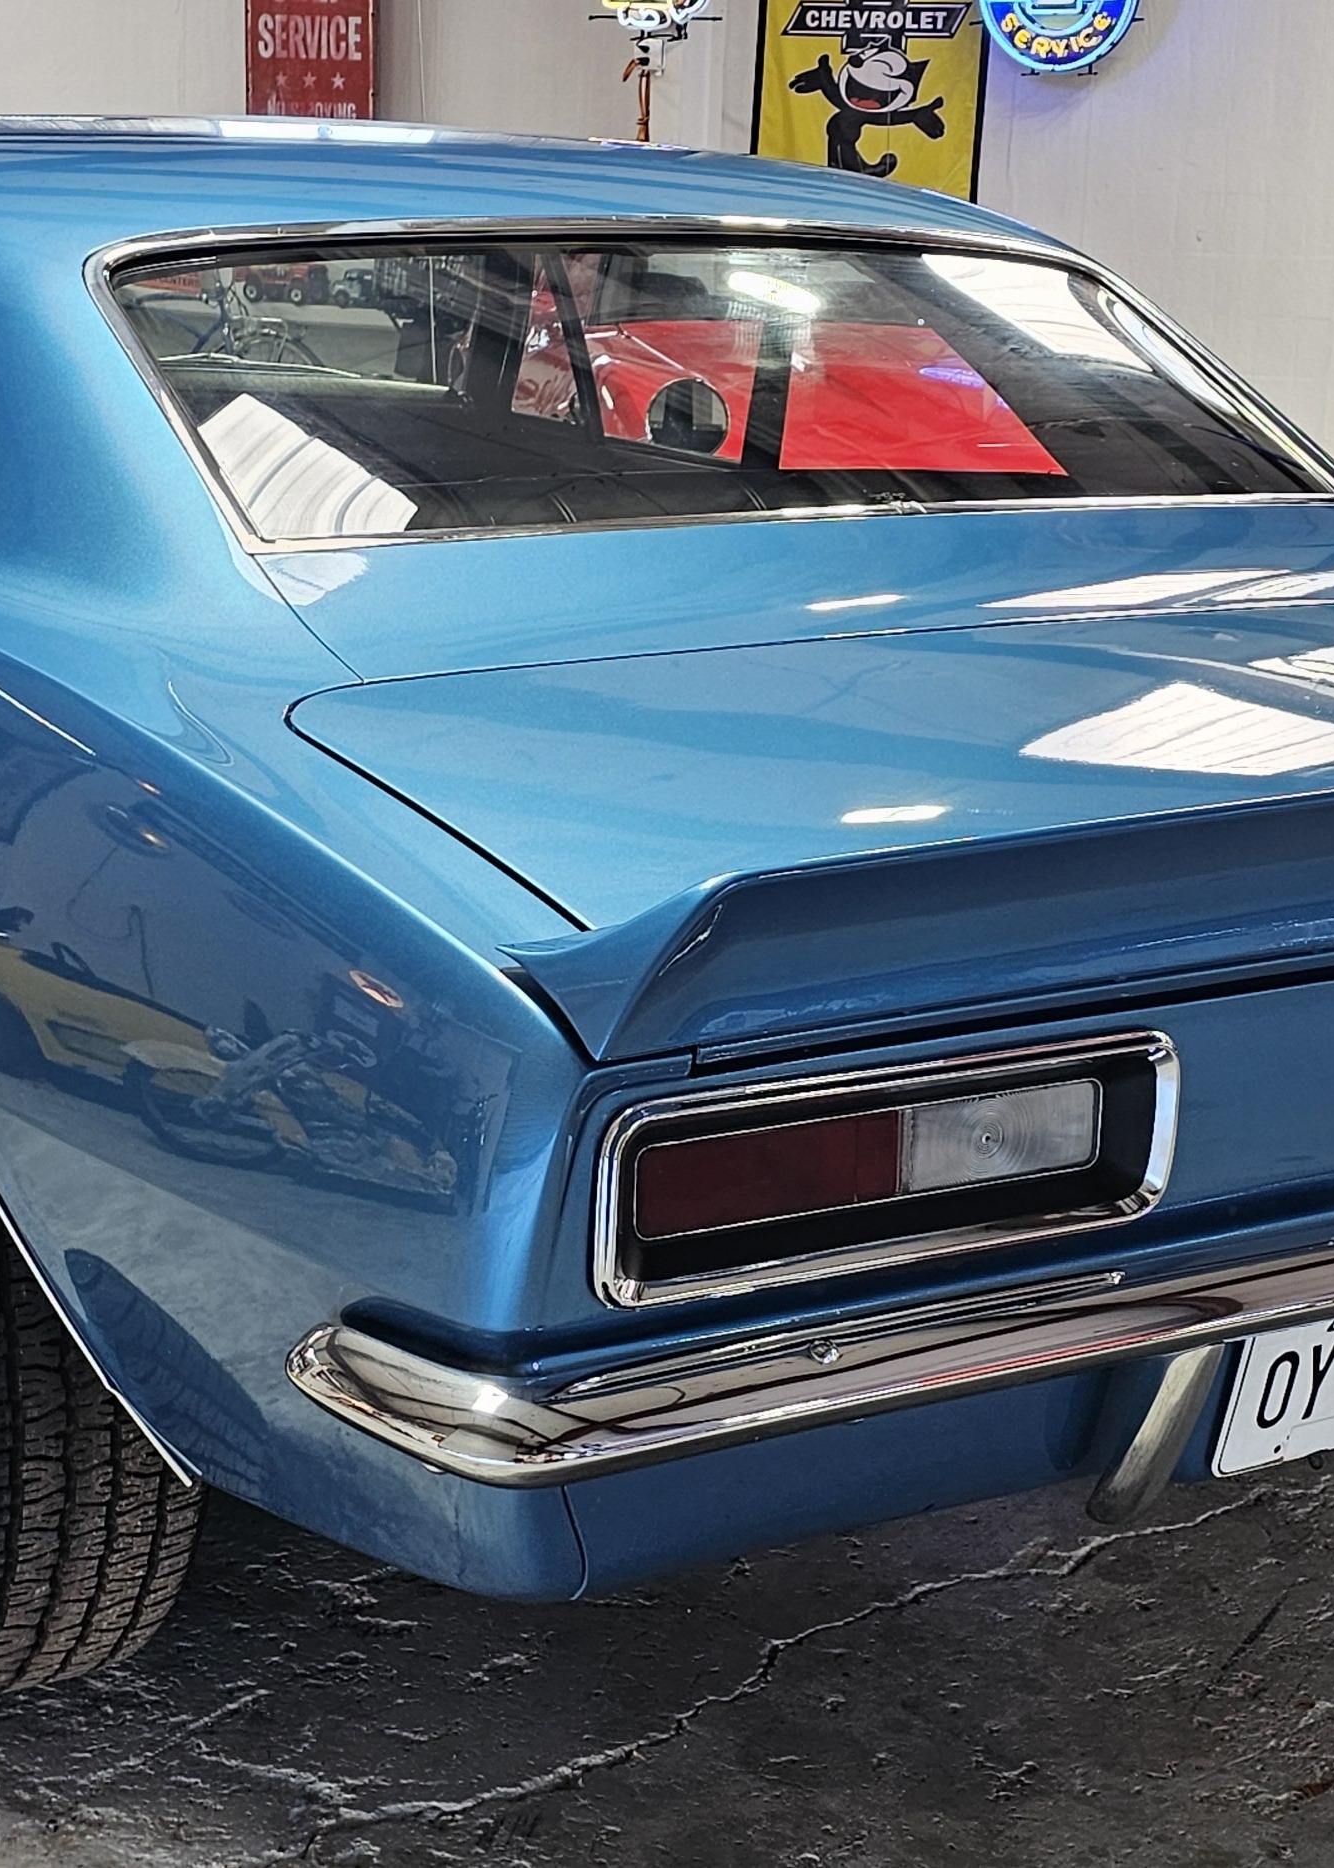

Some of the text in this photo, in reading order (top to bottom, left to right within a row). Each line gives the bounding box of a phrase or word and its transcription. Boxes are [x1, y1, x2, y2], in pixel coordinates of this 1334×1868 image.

[258, 13, 362, 60] SERVICE
[805, 10, 947, 29] CHEVROLET
[1001, 12, 1113, 58] SERVICE
